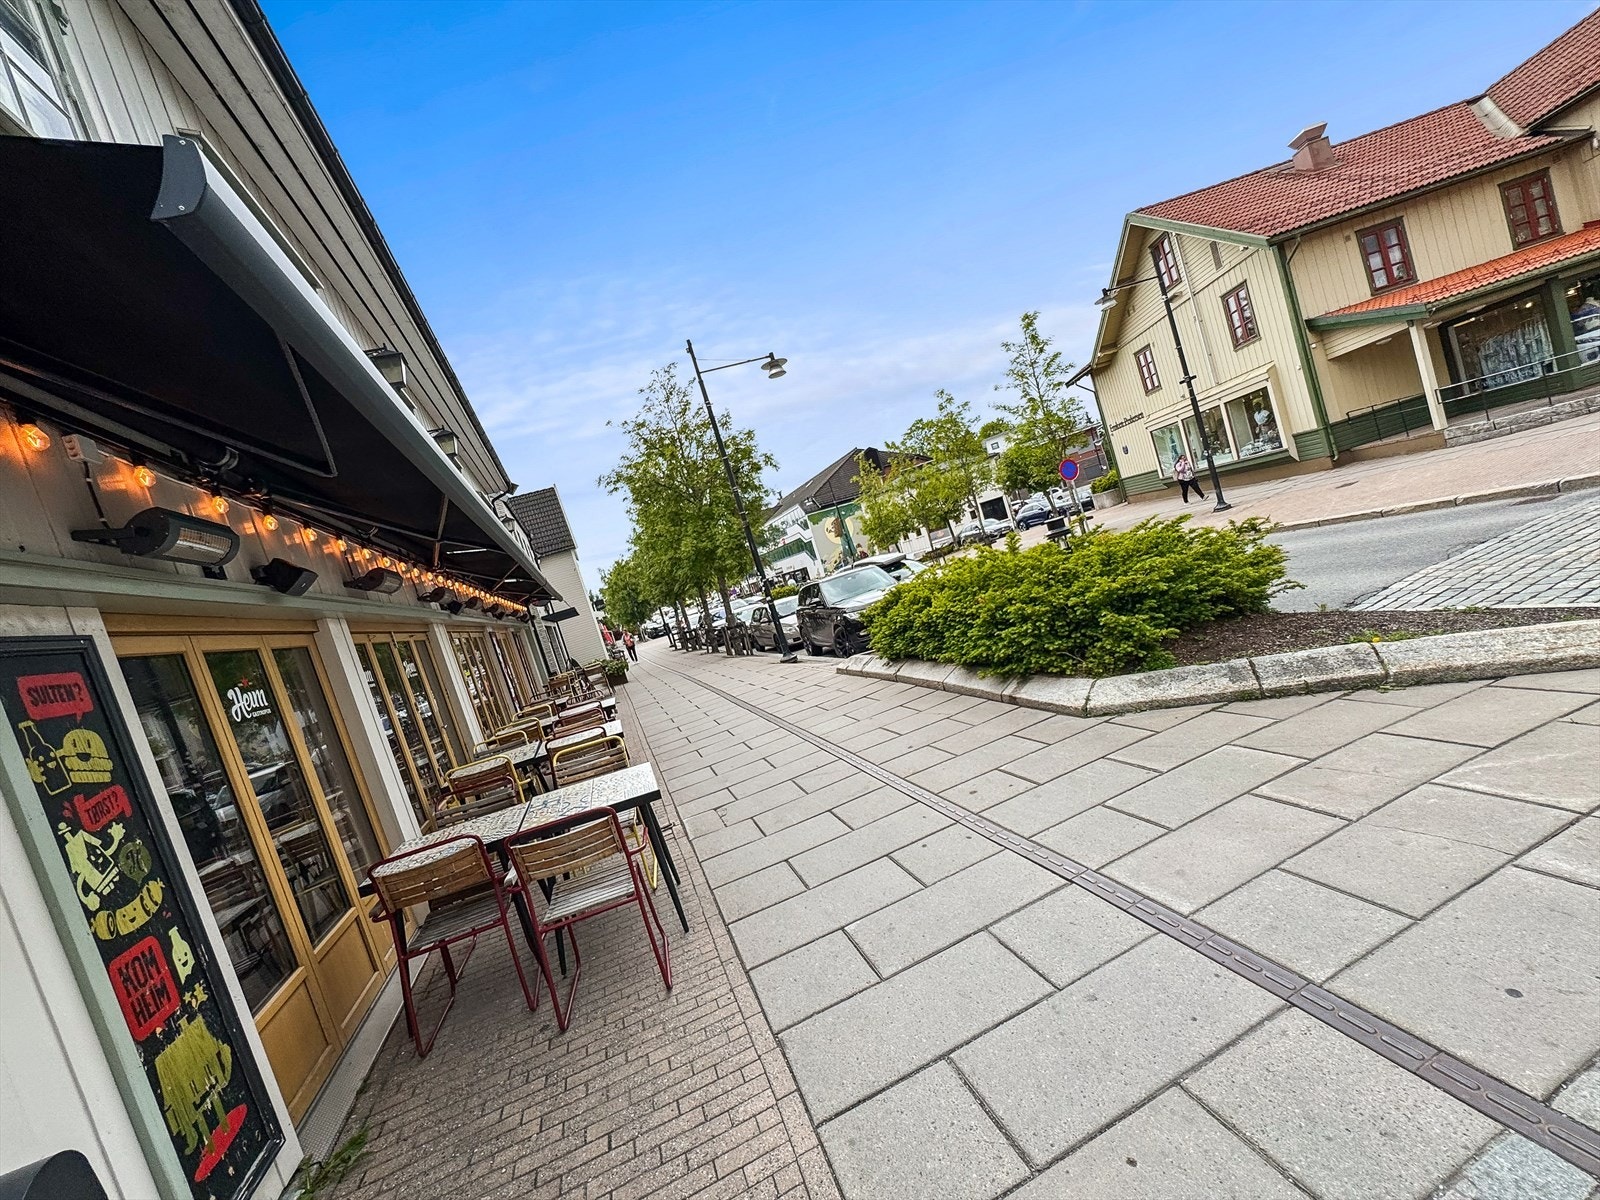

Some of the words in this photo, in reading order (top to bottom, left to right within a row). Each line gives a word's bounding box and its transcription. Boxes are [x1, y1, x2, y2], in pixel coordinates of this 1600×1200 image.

[27, 683, 84, 707] SULTEN?
[227, 686, 269, 722] Heim
[84, 790, 120, 825] TØRST?
[117, 945, 162, 999] KOM
[130, 976, 172, 1028] HEIM
